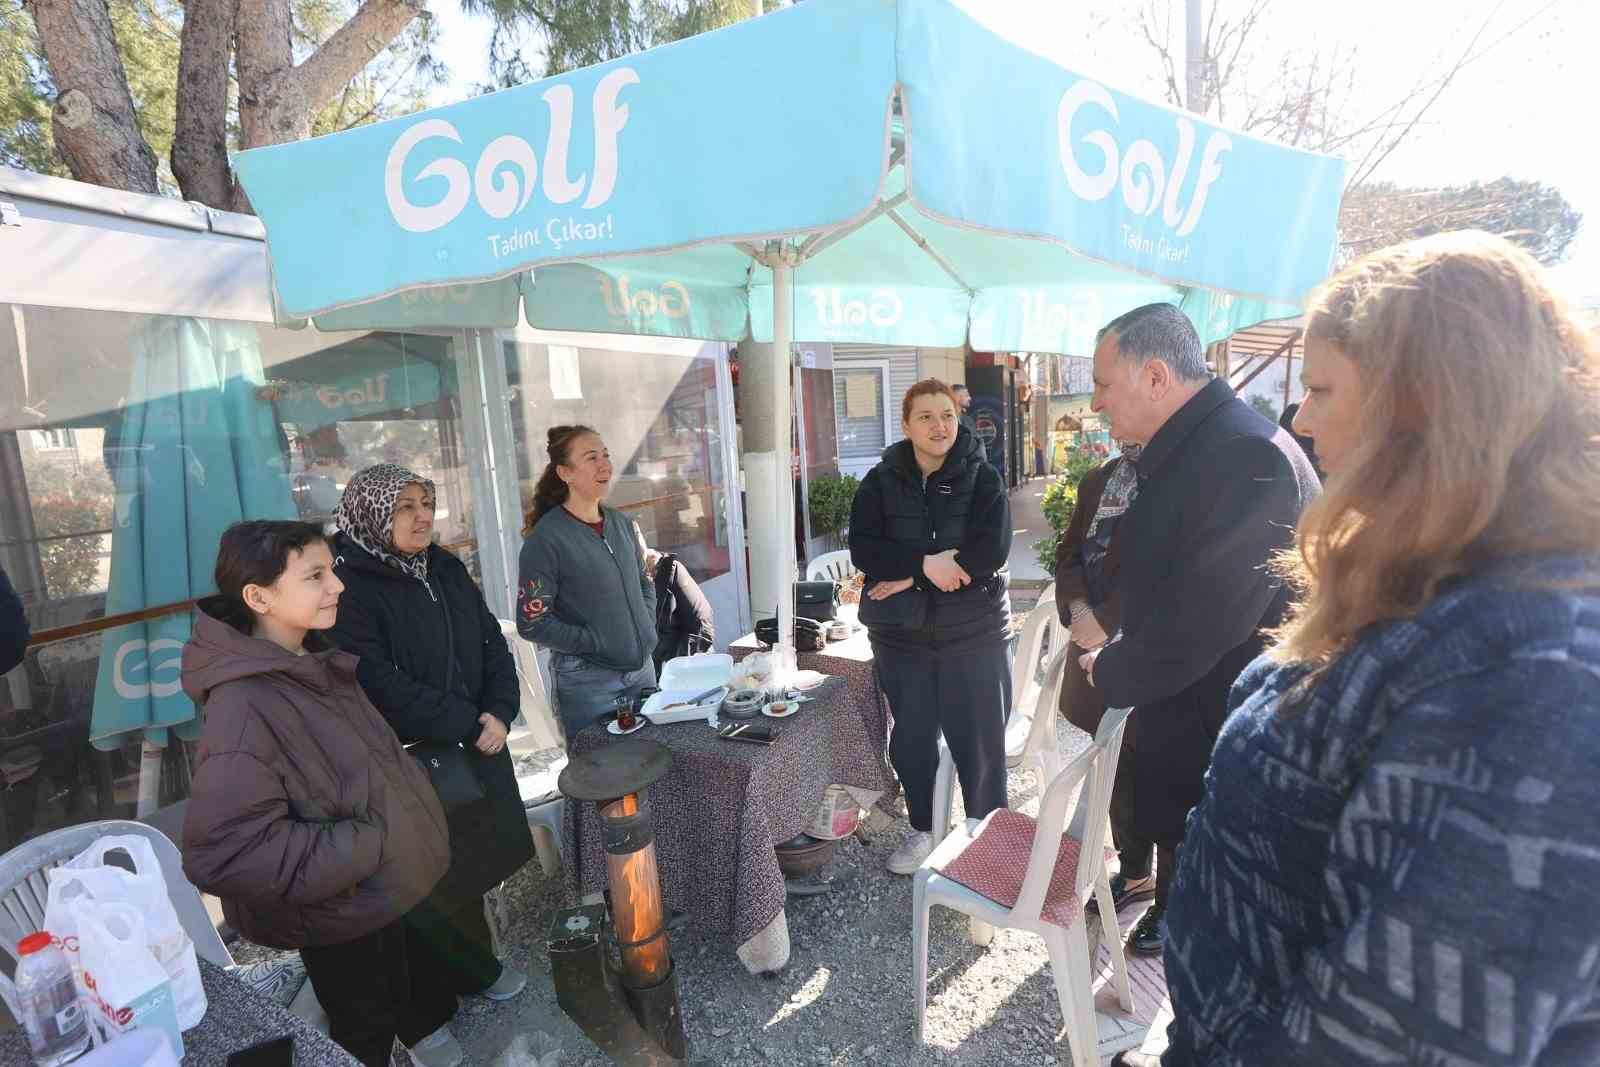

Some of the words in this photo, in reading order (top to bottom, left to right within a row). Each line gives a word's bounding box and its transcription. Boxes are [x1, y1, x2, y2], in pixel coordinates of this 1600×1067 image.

[385, 67, 640, 233] Golf
[1057, 79, 1233, 237] Golf
[487, 227, 540, 258] Tadını
[546, 213, 615, 250] Çıkar!
